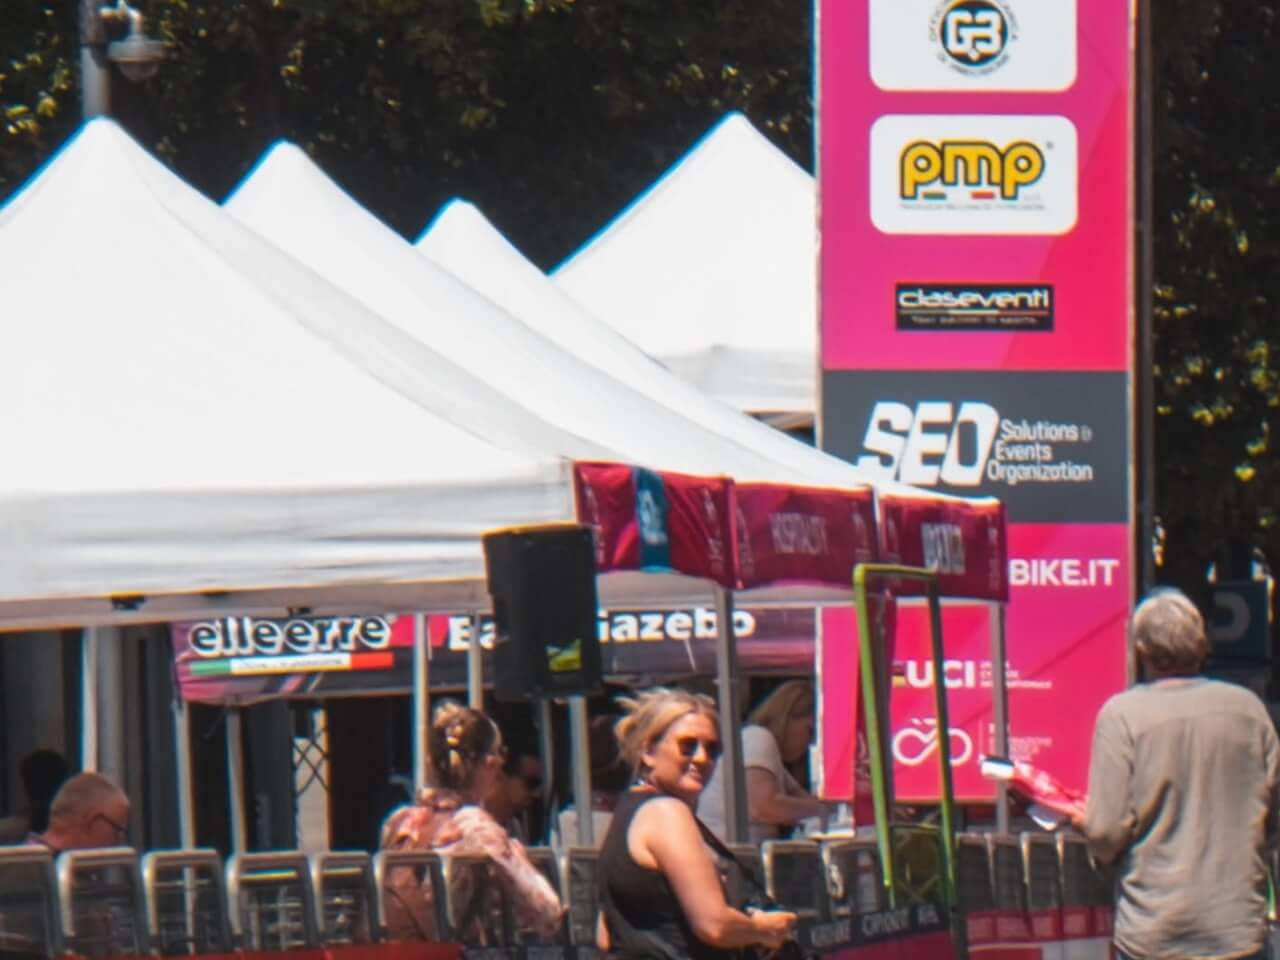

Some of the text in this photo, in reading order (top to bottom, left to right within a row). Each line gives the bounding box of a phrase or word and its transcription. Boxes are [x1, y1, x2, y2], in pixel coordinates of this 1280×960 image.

[899, 140, 1046, 200] pmp
[857, 400, 999, 487] SEO
[1001, 418, 1079, 442] Solutions
[995, 443, 1053, 462] Events
[987, 460, 1093, 486] Organization
[1009, 559, 1120, 586] BIKE.IT
[188, 613, 392, 658] elleerre
[906, 660, 975, 688] UCI
